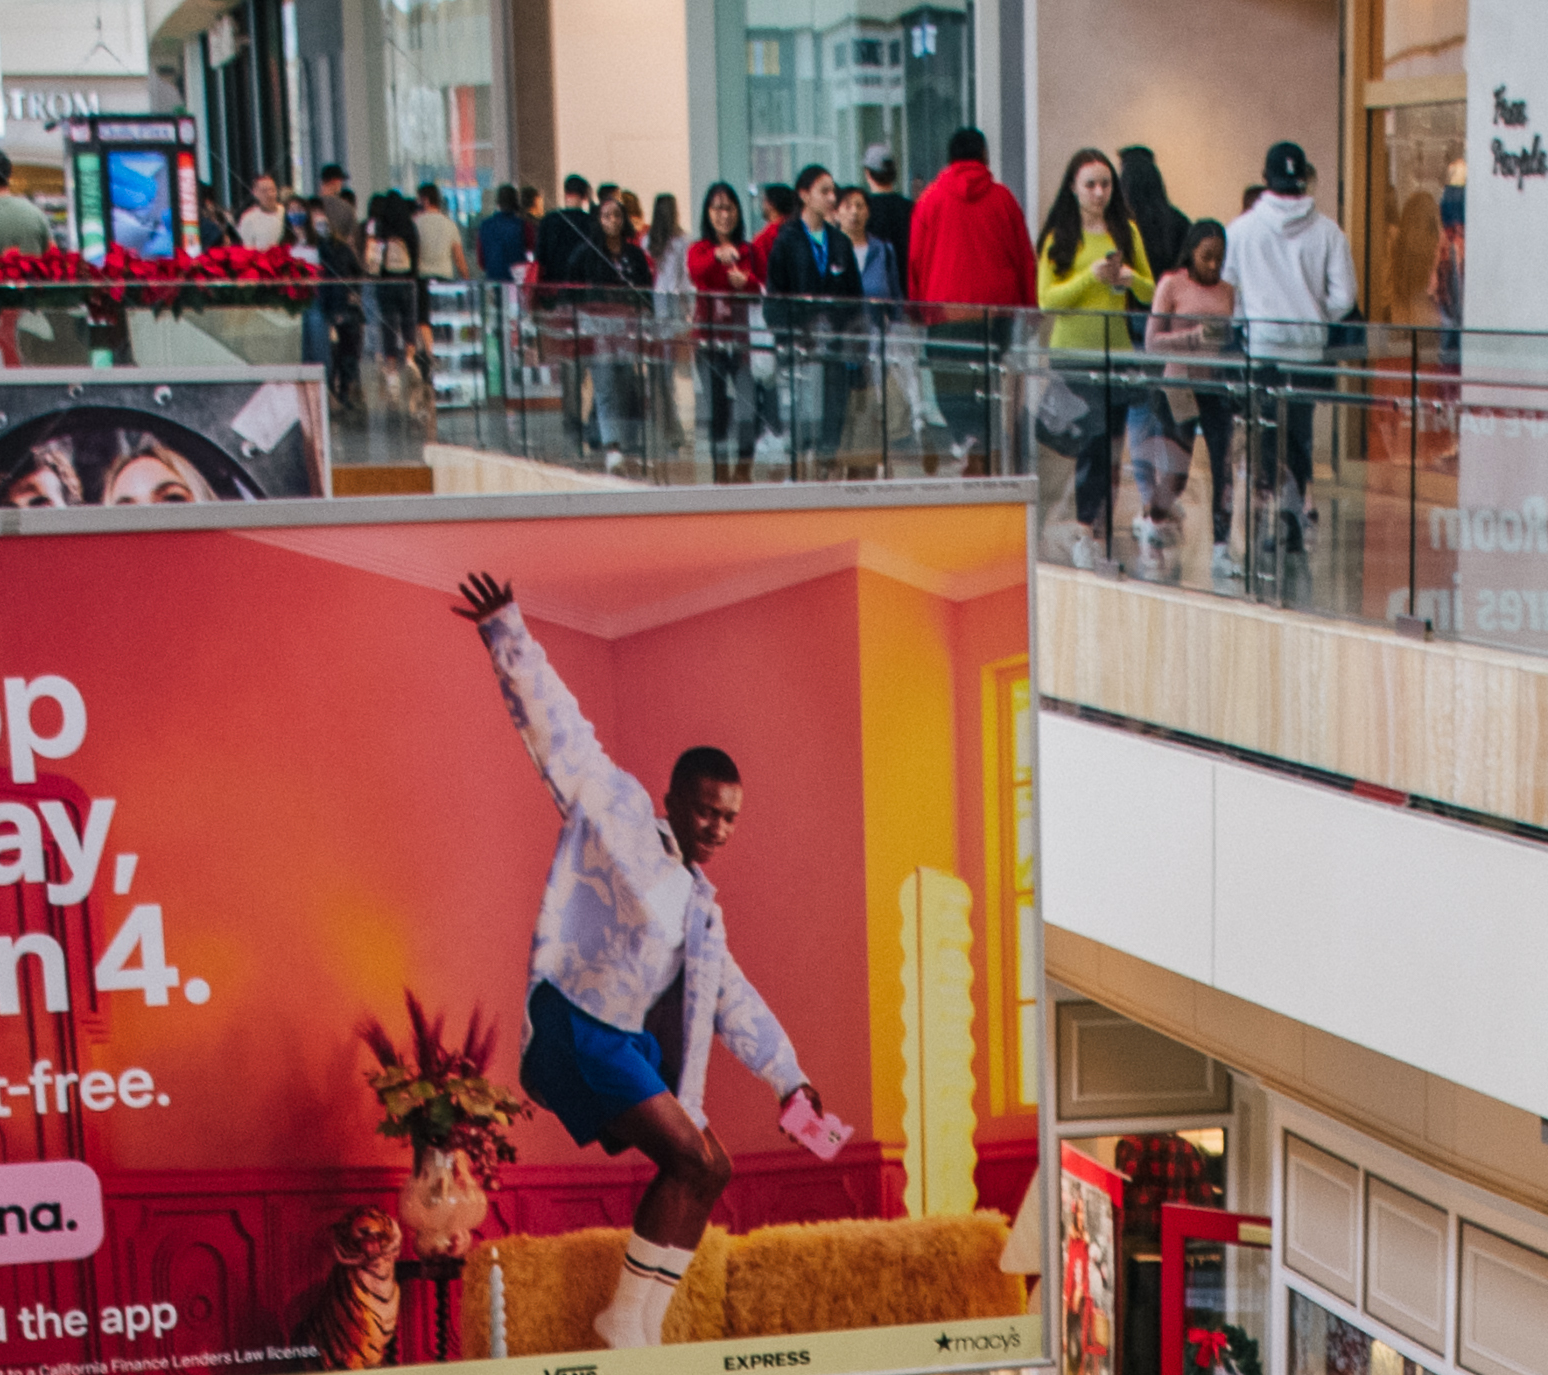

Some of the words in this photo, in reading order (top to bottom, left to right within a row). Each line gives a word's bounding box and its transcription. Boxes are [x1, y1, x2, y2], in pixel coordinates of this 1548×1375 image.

[1491, 135, 1548, 191] People
[95, 904, 213, 1009] 4.
[18, 1302, 90, 1345] the
[98, 1297, 179, 1342] app
[954, 1327, 1022, 1353] macy's
[111, 1356, 169, 1373] Finance
[171, 1352, 233, 1369] Lenders
[234, 1347, 265, 1363] Law
[723, 1350, 811, 1372] EXPRESS
